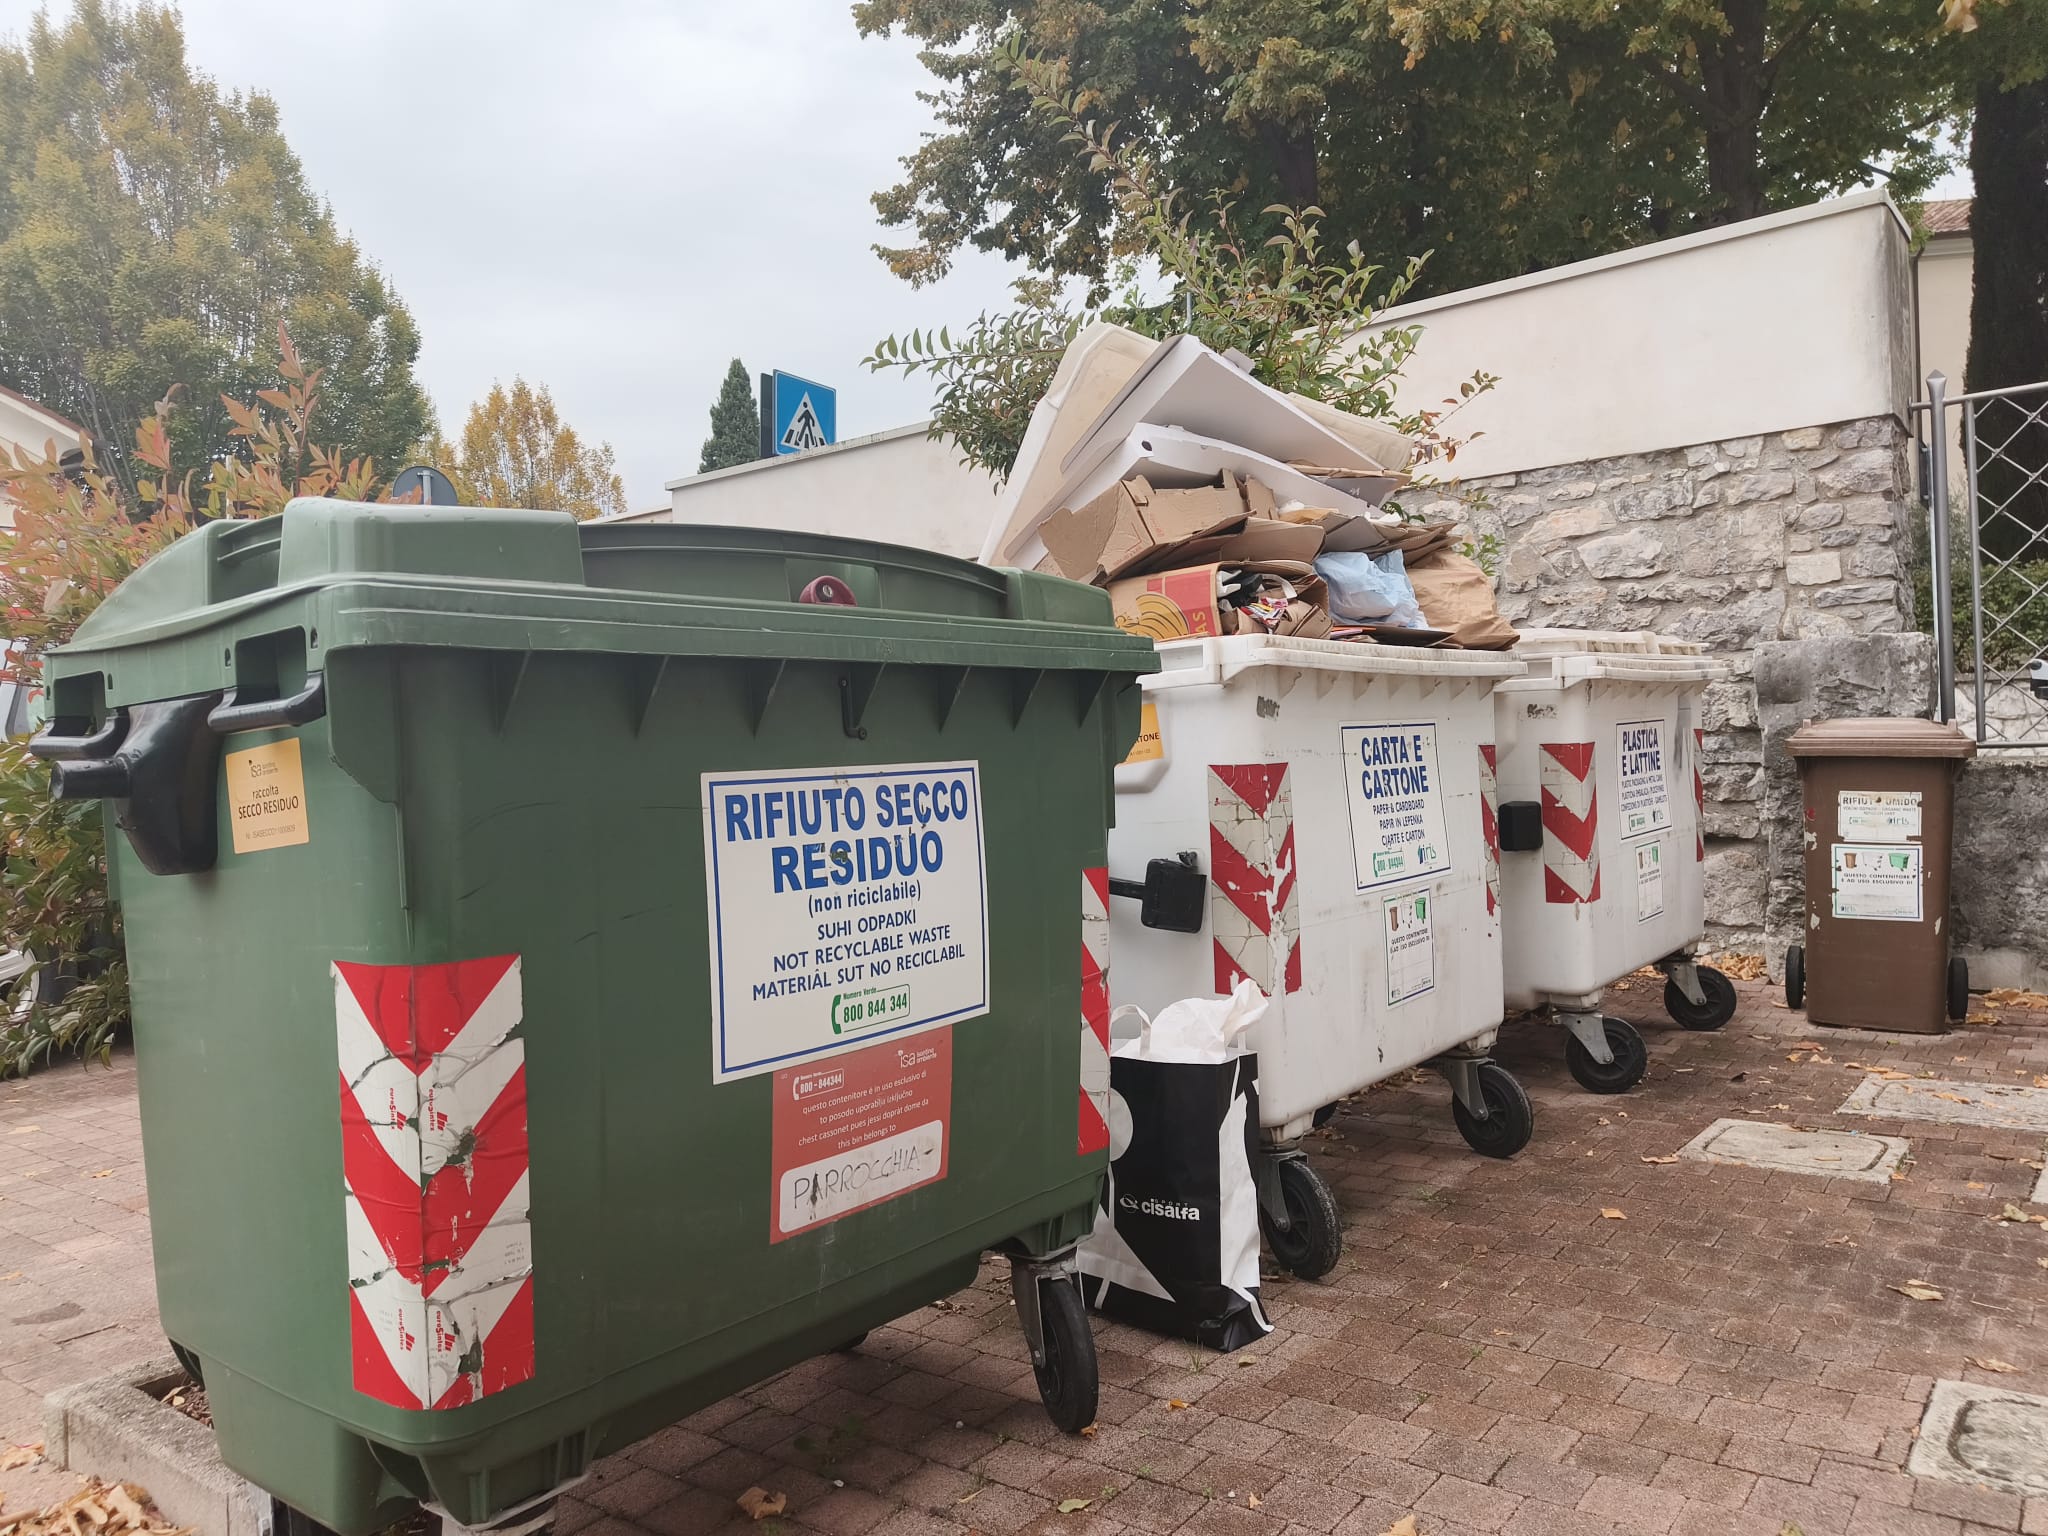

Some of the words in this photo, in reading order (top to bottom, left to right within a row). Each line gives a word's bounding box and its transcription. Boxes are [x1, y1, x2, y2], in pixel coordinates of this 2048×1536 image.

[1136, 732, 1160, 743] TONE
[1623, 728, 1659, 752] PLASTICA
[1361, 735, 1408, 767] CARTA
[1413, 734, 1423, 762] E
[1622, 755, 1628, 776] E
[1630, 751, 1661, 775] LATTINE
[252, 785, 279, 800] raccolta
[1361, 765, 1430, 800] CARTONE
[238, 802, 262, 820] SECCO
[264, 795, 299, 814] RESIDUO
[725, 786, 866, 842] RIFIUTO
[875, 779, 968, 828] SECCO
[1373, 804, 1389, 815] PAPER
[1396, 799, 1425, 812] CARDBOARD
[1379, 818, 1394, 830] PAPIR
[1396, 817, 1402, 828] IN
[1403, 814, 1423, 827] LEPENKA
[1401, 832, 1405, 843] E
[1406, 829, 1425, 842] CARTON
[772, 830, 944, 894] RESIDUO
[808, 894, 842, 918] (non
[847, 879, 921, 908] riciclabile)
[817, 919, 852, 940] SUHI
[858, 909, 916, 933] ODPADKI
[773, 951, 808, 973] NOT
[815, 934, 904, 966] RECYCLABLE
[909, 924, 950, 946] WASTE
[752, 968, 831, 1001] MATERIÂL
[837, 964, 865, 985] SUT
[870, 959, 891, 978] NO
[897, 943, 965, 971] RECICLABIL
[843, 1004, 863, 1024] 800
[867, 998, 886, 1017] 844
[890, 993, 907, 1012] 344
[898, 1050, 916, 1069] isa
[800, 1081, 813, 1094] 800
[819, 1073, 842, 1089] 844344
[803, 1100, 827, 1115] questo
[828, 1089, 868, 1107] contenitore
[875, 1084, 880, 1092] in
[882, 1081, 893, 1091] uso
[894, 1073, 920, 1086] esclusivo
[922, 1070, 927, 1078] di
[799, 1133, 818, 1146] chest
[819, 1124, 849, 1140] cassonet
[851, 1120, 866, 1131] pues
[867, 1114, 881, 1126] jessi
[904, 1102, 920, 1113] dome
[922, 1098, 929, 1107] da
[820, 1115, 827, 1125] to
[829, 1109, 854, 1123] posodo
[838, 1139, 850, 1149] this
[852, 1136, 862, 1146] bin
[864, 1128, 888, 1141] belongs
[890, 1124, 896, 1133] to
[1141, 1198, 1200, 1221] cisalfa
